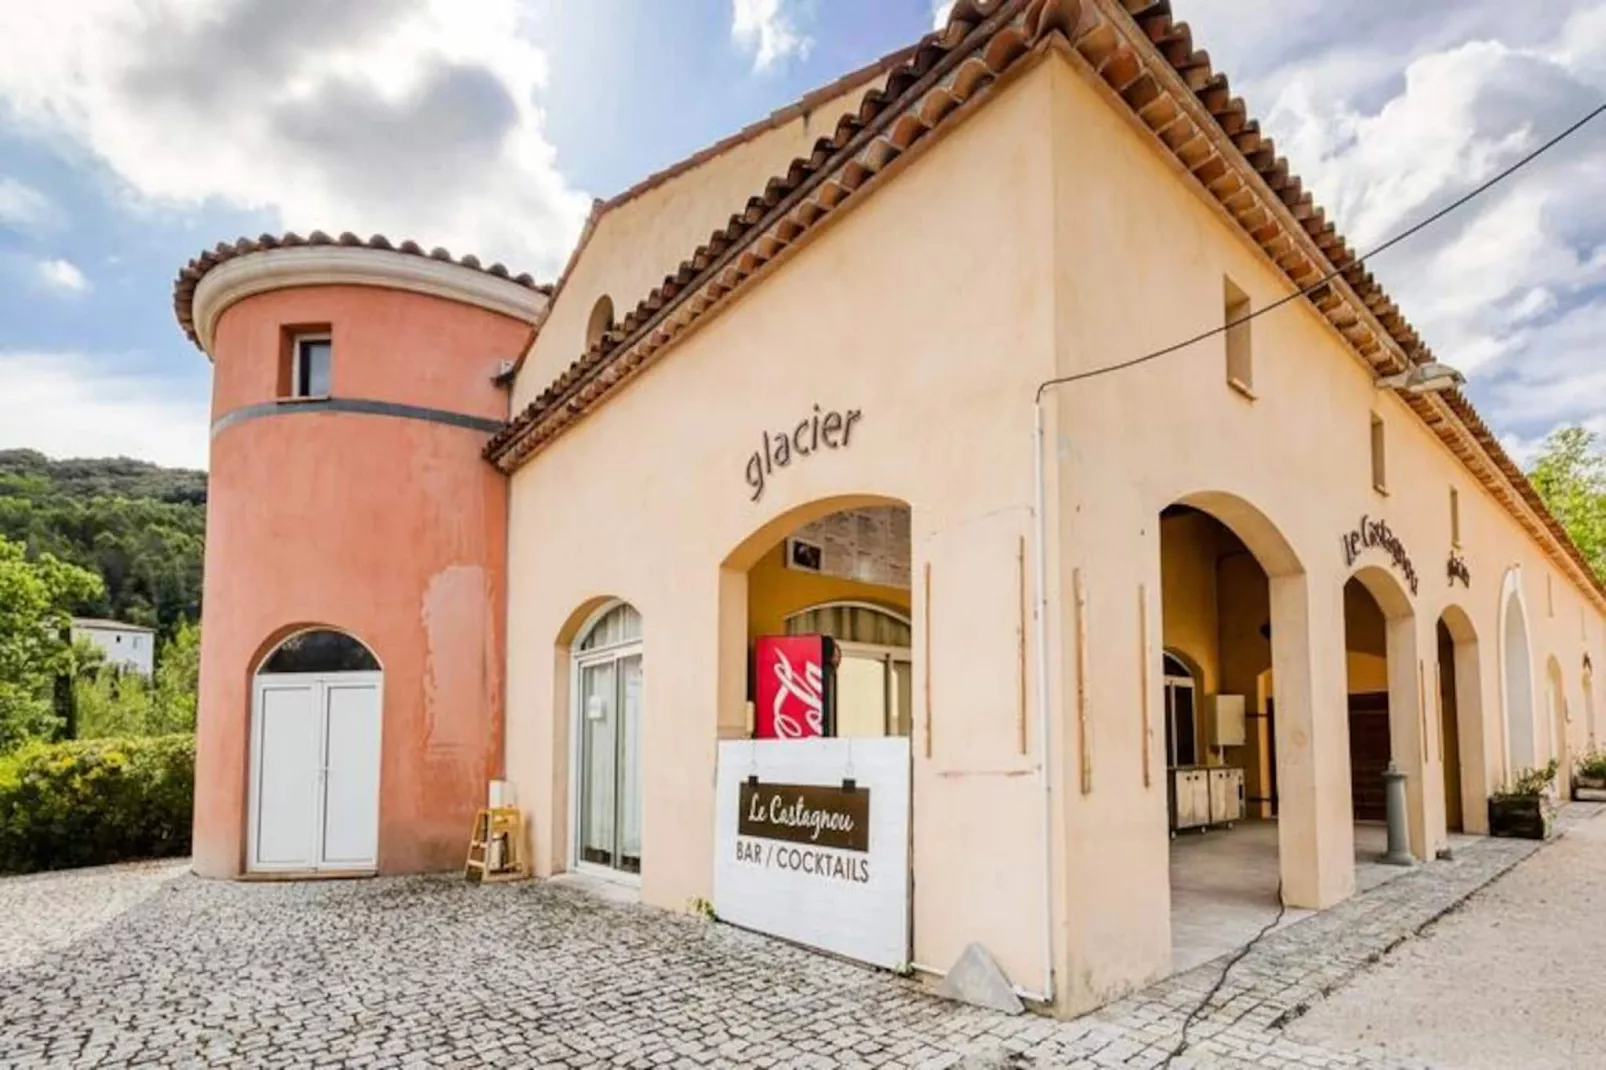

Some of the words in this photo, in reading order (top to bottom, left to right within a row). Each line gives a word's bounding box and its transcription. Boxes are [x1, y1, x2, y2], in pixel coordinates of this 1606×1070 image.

[745, 403, 862, 502] glacier
[748, 792, 768, 822] Le
[769, 794, 854, 841] Castagnou
[736, 841, 762, 865] BAR
[776, 846, 870, 884] COCKTAILS
